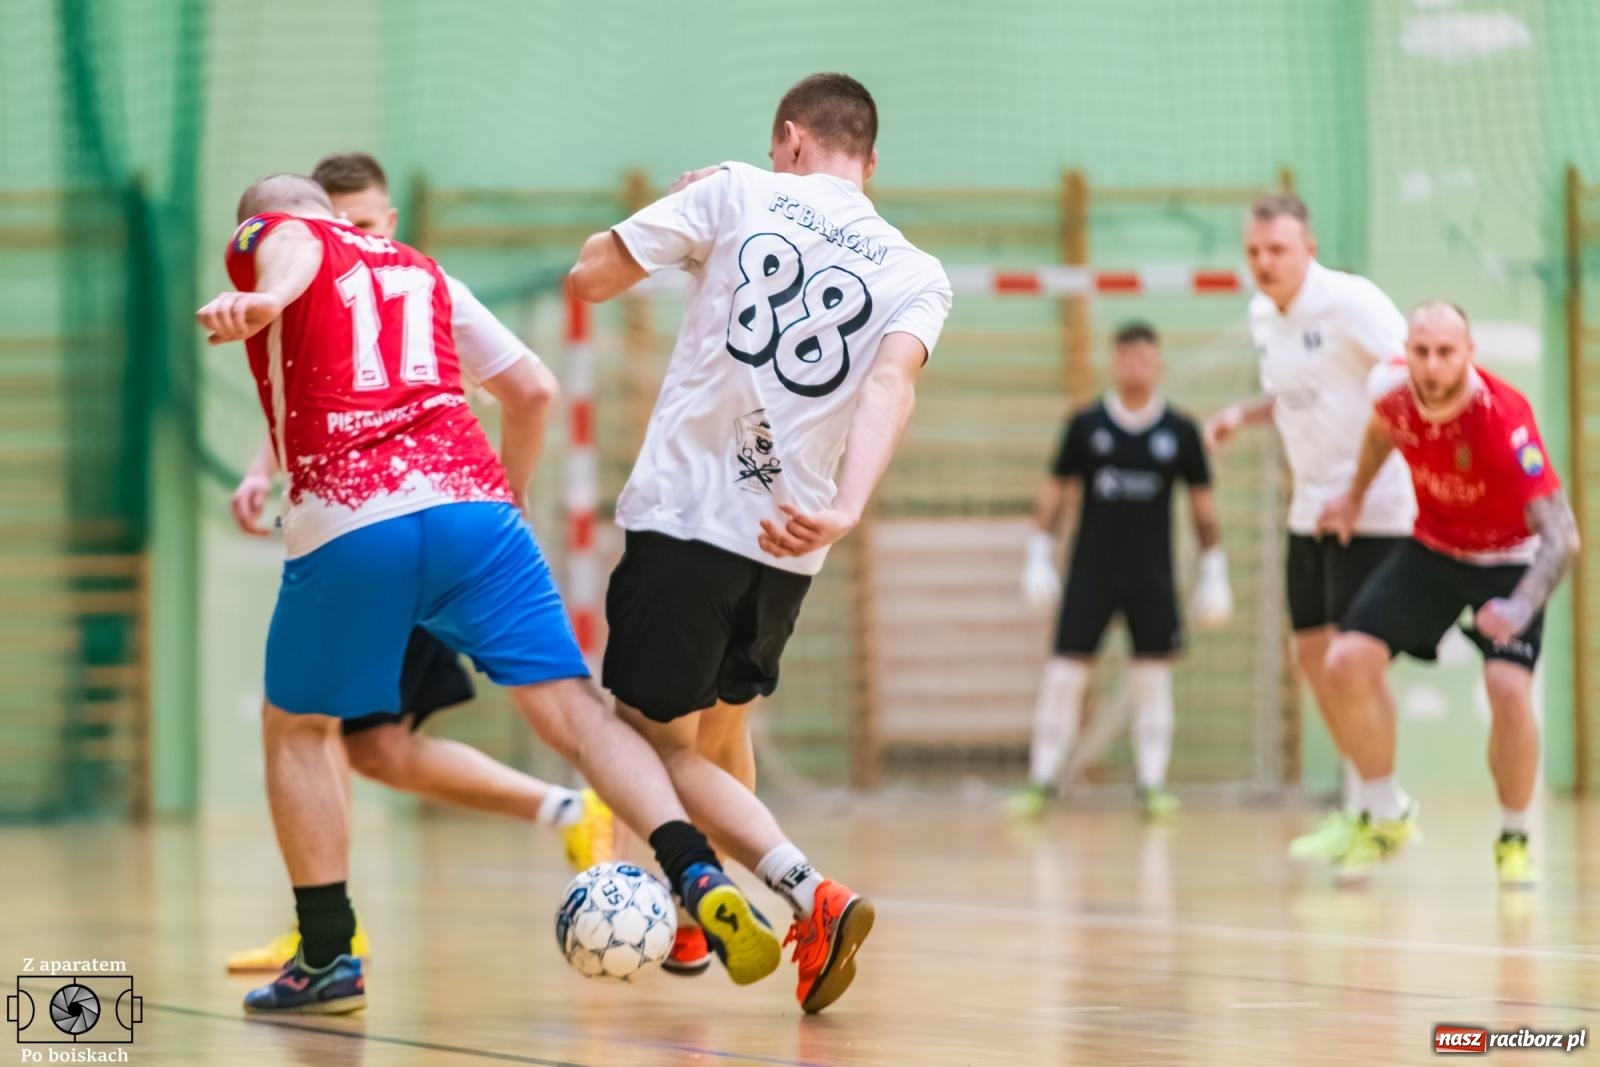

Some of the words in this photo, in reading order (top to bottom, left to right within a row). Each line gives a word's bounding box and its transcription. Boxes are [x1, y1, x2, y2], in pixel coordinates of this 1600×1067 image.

[768, 192, 800, 220] FC
[335, 259, 441, 392] 17
[726, 232, 873, 398] 88
